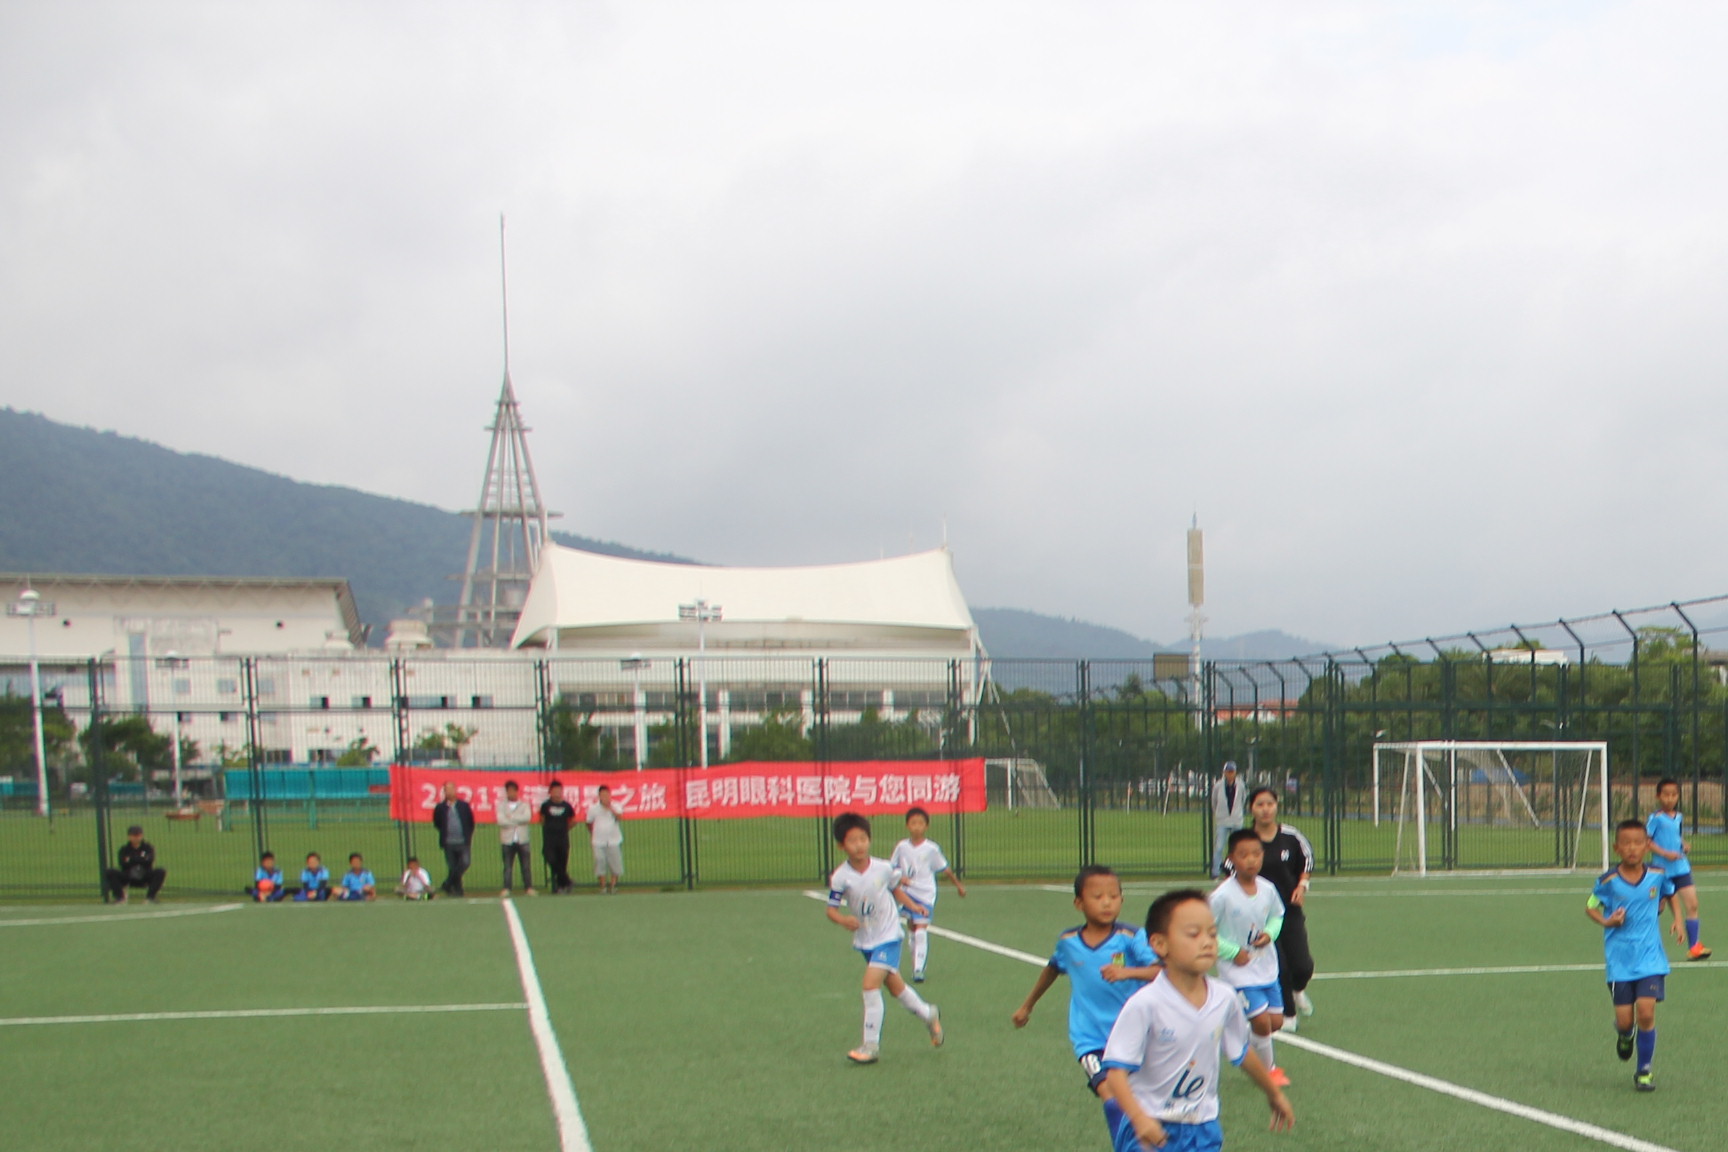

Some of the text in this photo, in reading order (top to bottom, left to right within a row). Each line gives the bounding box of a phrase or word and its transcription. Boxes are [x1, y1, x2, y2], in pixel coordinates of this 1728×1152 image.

[685, 774, 961, 809] 昆明眼科医院与您同游
